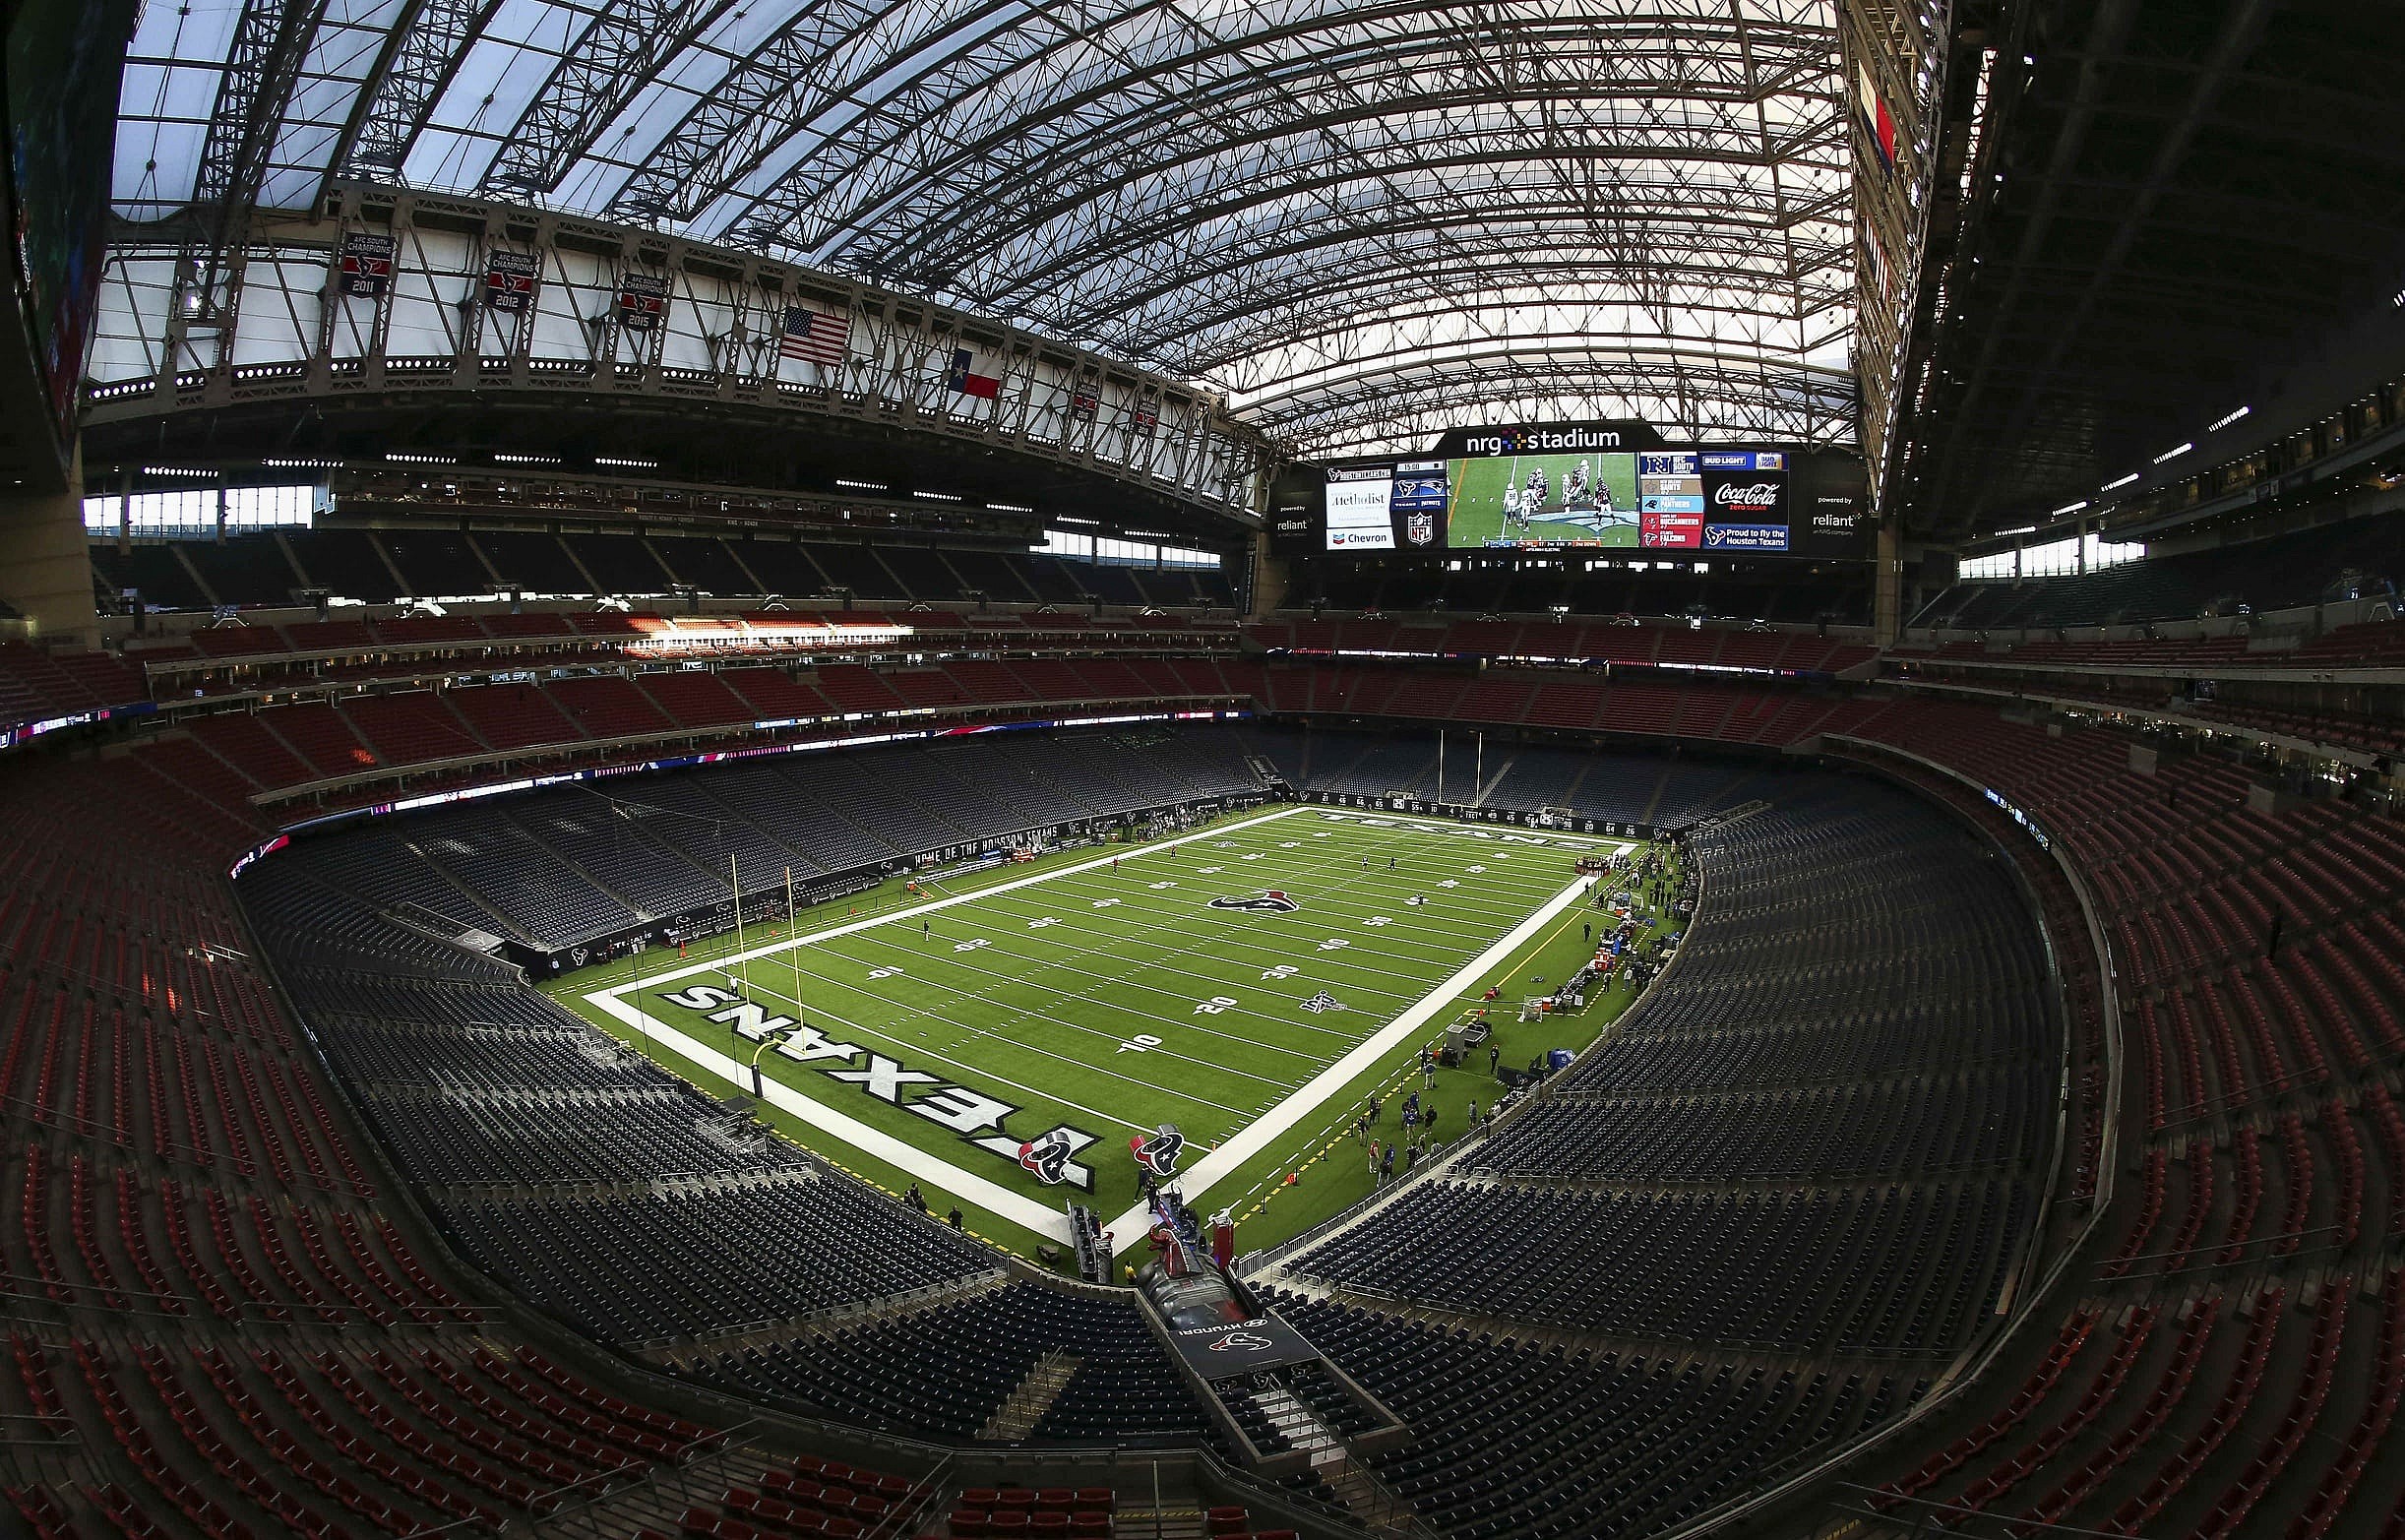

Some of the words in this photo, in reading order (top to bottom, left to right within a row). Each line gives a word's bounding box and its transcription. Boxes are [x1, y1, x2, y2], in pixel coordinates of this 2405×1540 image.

[347, 242, 392, 254] CHAMPIONS
[367, 237, 389, 246] SOUTH
[493, 259, 533, 272] CHAMPIONS
[352, 279, 374, 292] 2011
[626, 280, 663, 294] CHAMPIONS
[495, 294, 519, 308] 2012
[629, 314, 649, 327] 2015
[1466, 436, 1502, 456] nrg
[1527, 428, 1621, 450] stadium
[1332, 493, 1385, 506] Methodist
[1714, 483, 1780, 506] Coca-Cola
[1277, 520, 1308, 530] reliant
[1813, 514, 1854, 526] reliant
[1348, 533, 1387, 542] Chevron
[1411, 527, 1430, 540] NFL
[1759, 529, 1770, 538] fly
[945, 847, 958, 859] OF
[960, 841, 977, 857] THE
[1264, 964, 1300, 980] 30
[1195, 996, 1238, 1015] 20
[1120, 1033, 1163, 1052] 10
[655, 984, 1104, 1195] TEXANS
[1179, 1324, 1241, 1336] HYUNDAI
